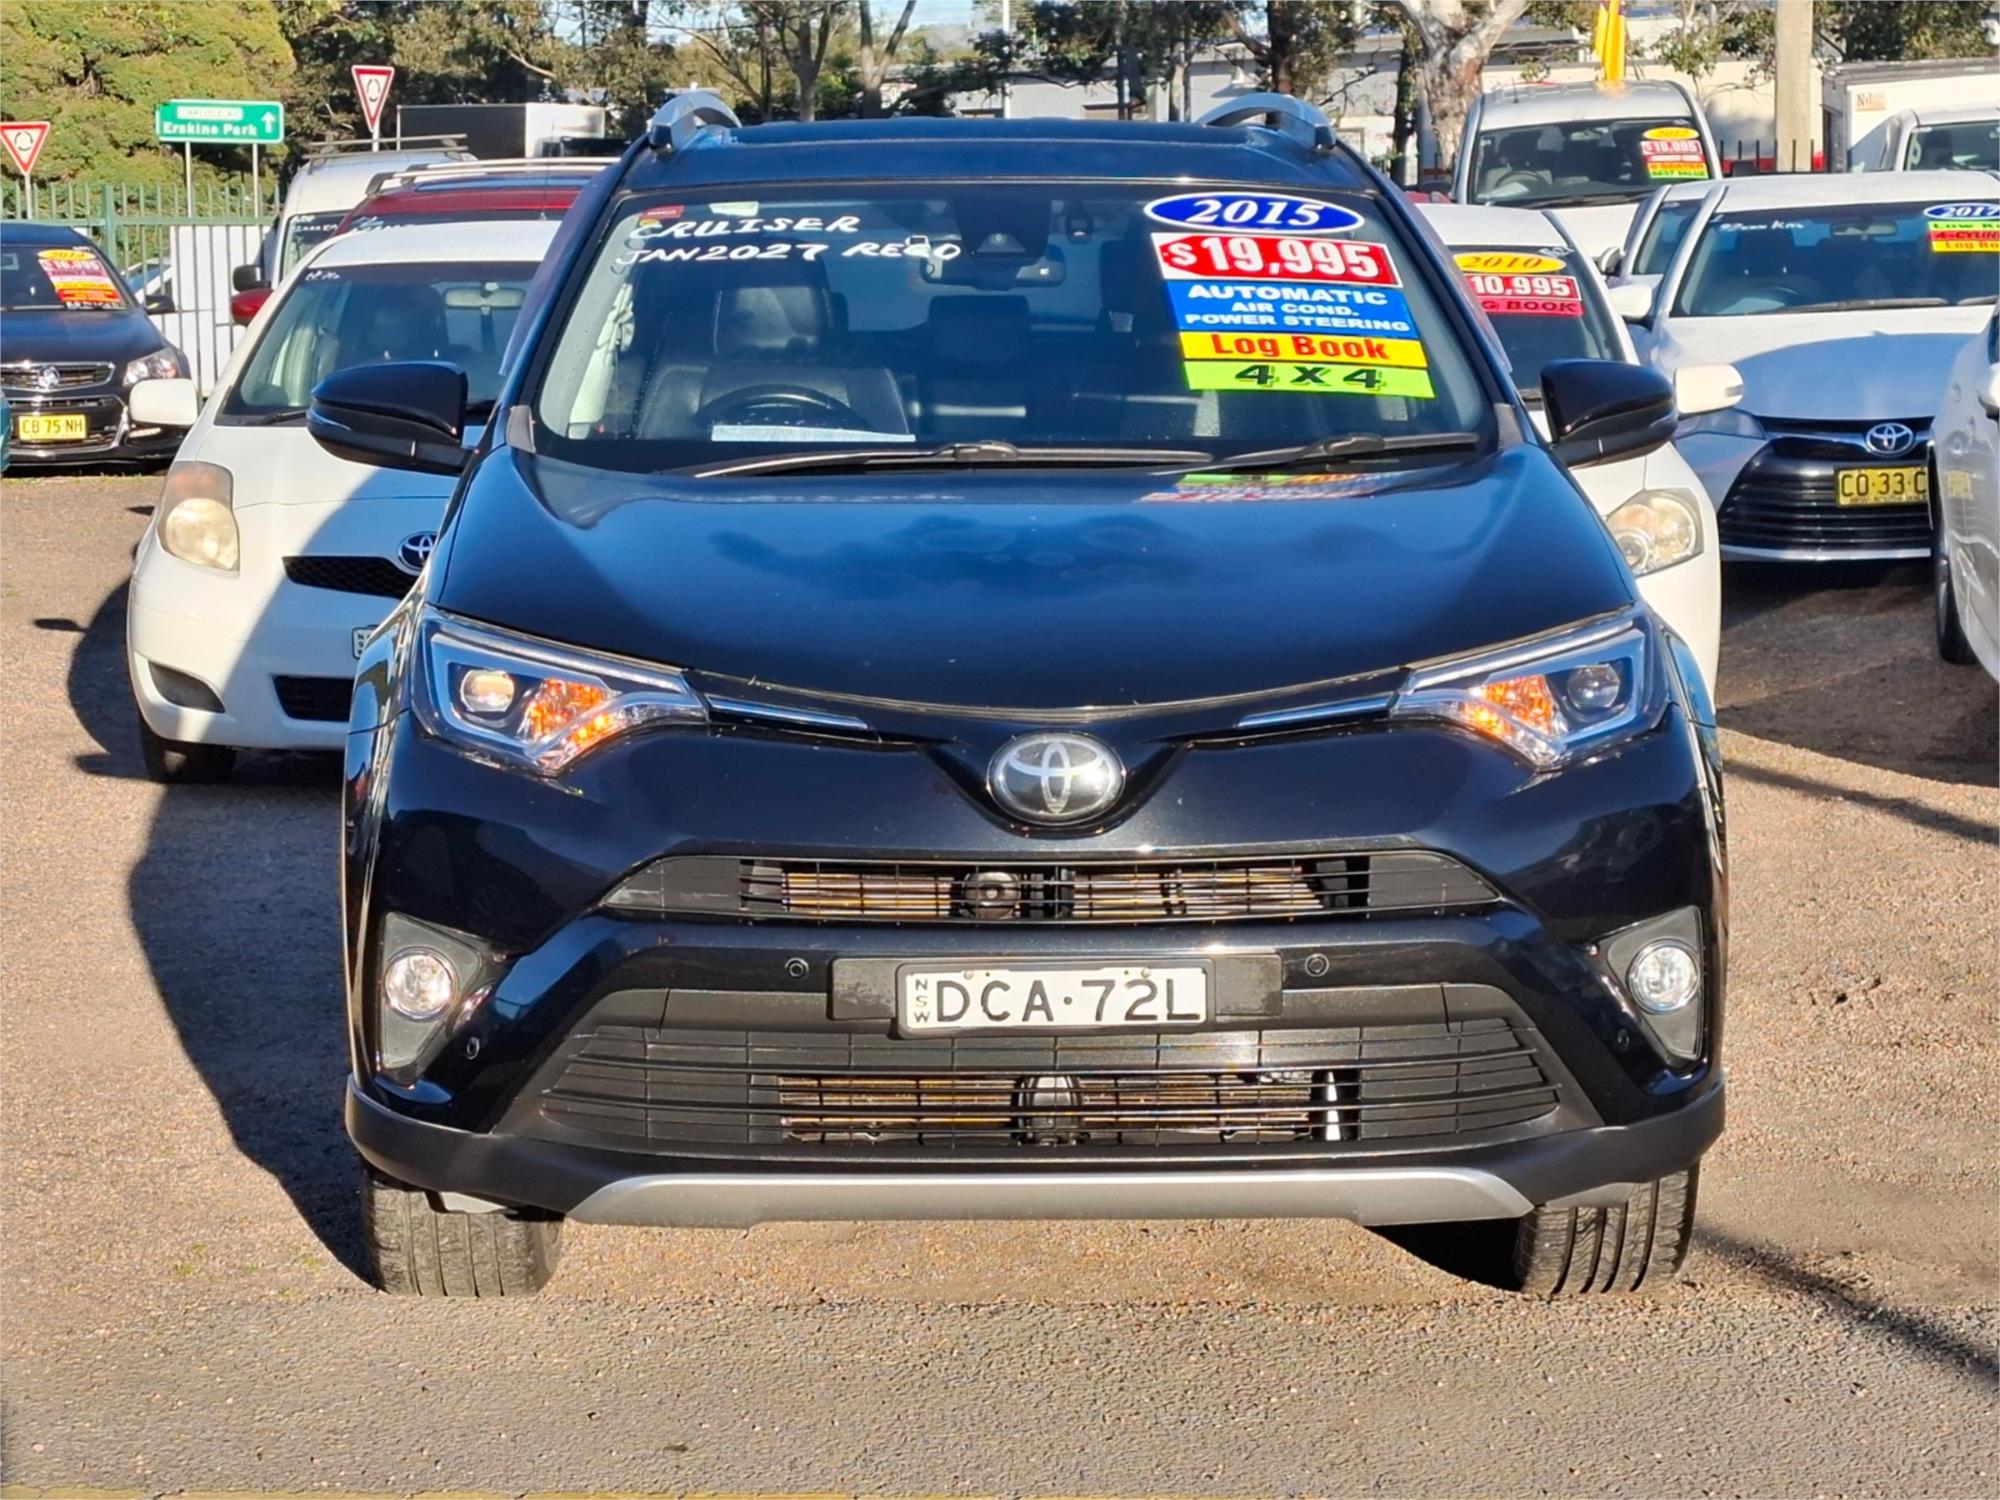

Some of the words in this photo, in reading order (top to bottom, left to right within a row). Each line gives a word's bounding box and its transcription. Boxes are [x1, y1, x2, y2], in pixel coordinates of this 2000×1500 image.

[163, 121, 219, 135] Erskine
[223, 123, 258, 136] Park
[1185, 199, 1326, 227] 2015
[1940, 206, 1999, 218] 2017
[628, 215, 860, 239] CRUISER
[1167, 236, 1380, 279] $19,995
[1462, 256, 1544, 268] 2010
[1187, 283, 1389, 306] AUTOMATIC
[1231, 301, 1275, 313] AIR
[1280, 302, 1360, 317] COND.
[1506, 300, 1579, 312] BOOK
[1184, 313, 1278, 326] POWER
[1283, 315, 1411, 333] STEERING
[1211, 333, 1281, 358] Log
[1290, 335, 1390, 360] Book
[65, 418, 83, 433] NH
[914, 978, 931, 1024] NSW
